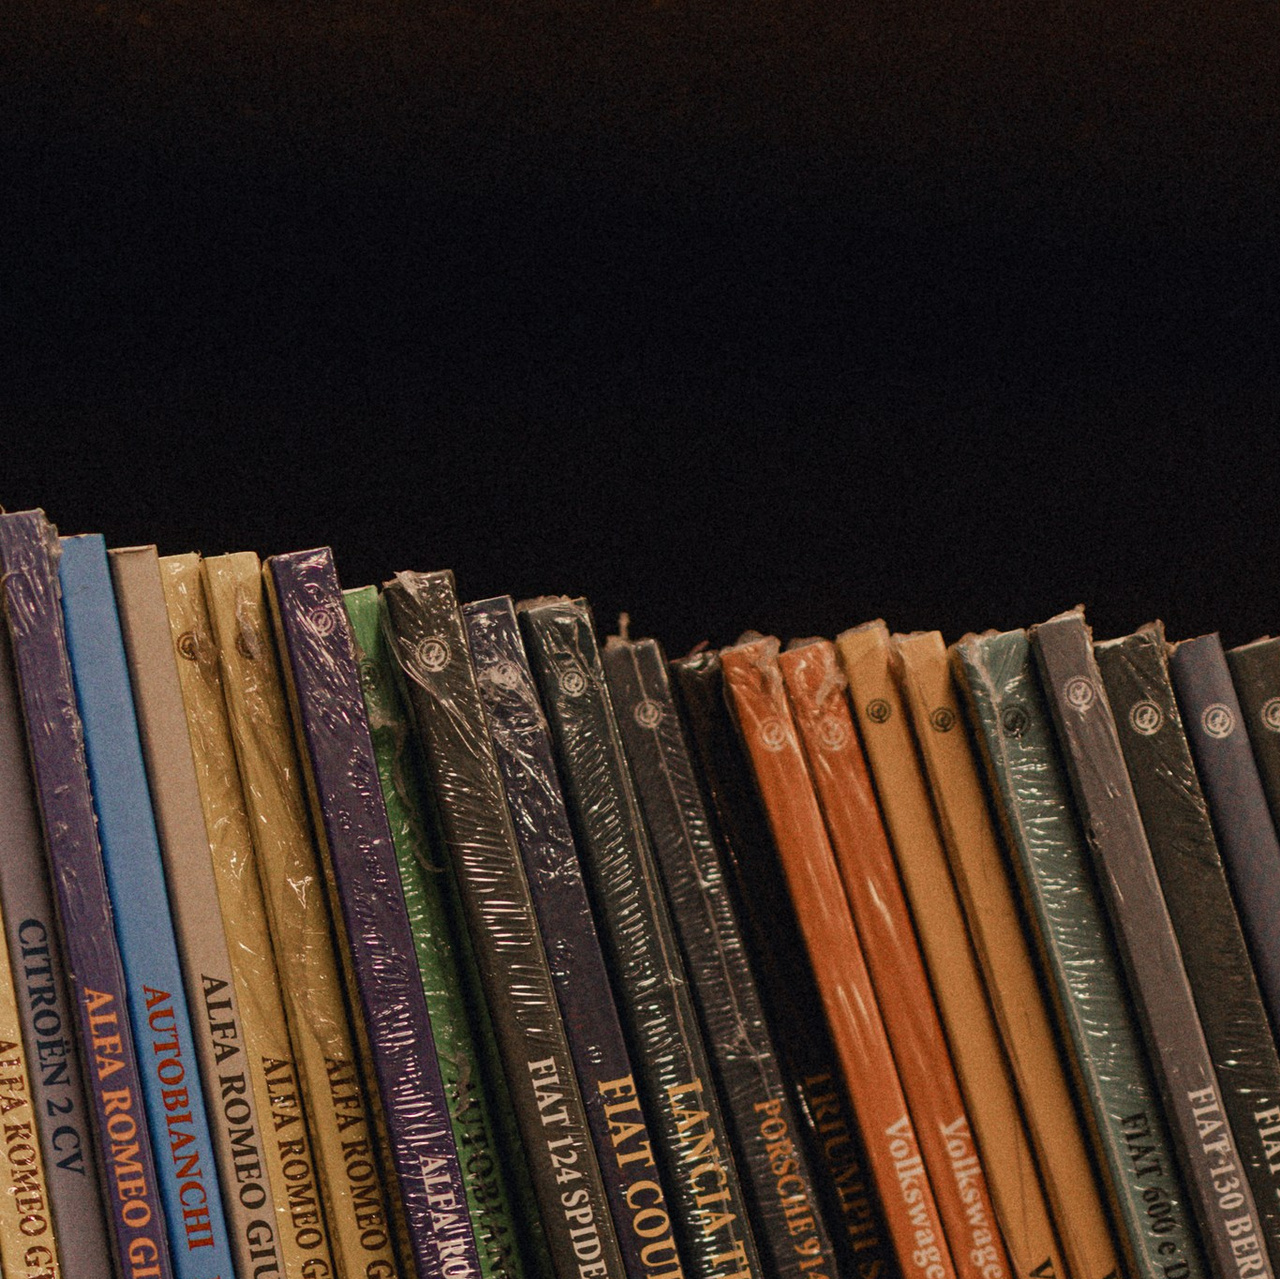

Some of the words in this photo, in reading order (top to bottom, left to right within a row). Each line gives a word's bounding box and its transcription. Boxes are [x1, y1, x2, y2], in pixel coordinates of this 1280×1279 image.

[18, 918, 71, 1087] CITROËN
[83, 986, 128, 1086] ALFA
[201, 973, 244, 1070] ALFA
[46, 1097, 73, 1117] 2
[143, 984, 214, 1252] AUTOBIANCHI
[219, 1074, 266, 1212] ROMEO
[261, 1057, 294, 1139] ALFA
[326, 1057, 360, 1138] ALFA
[527, 1055, 570, 1127] FIAT
[598, 1075, 650, 1169] FIAT
[4, 1120, 48, 1237] ROMEO
[52, 1125, 86, 1177] CV
[100, 1090, 150, 1230] ROMEO
[277, 1142, 323, 1252] ROMEO
[342, 1142, 389, 1253] ROMEO
[418, 1155, 460, 1235] ALFA
[547, 1134, 580, 1184] 124
[666, 1077, 737, 1239] LANCIA
[754, 1098, 814, 1237] PORSCHE
[805, 1074, 878, 1250] TRIUMPH
[1121, 1113, 1163, 1179] FIAT
[1142, 1187, 1174, 1236] 600
[1188, 1085, 1228, 1156] FIAT
[1212, 1163, 1243, 1210] 130
